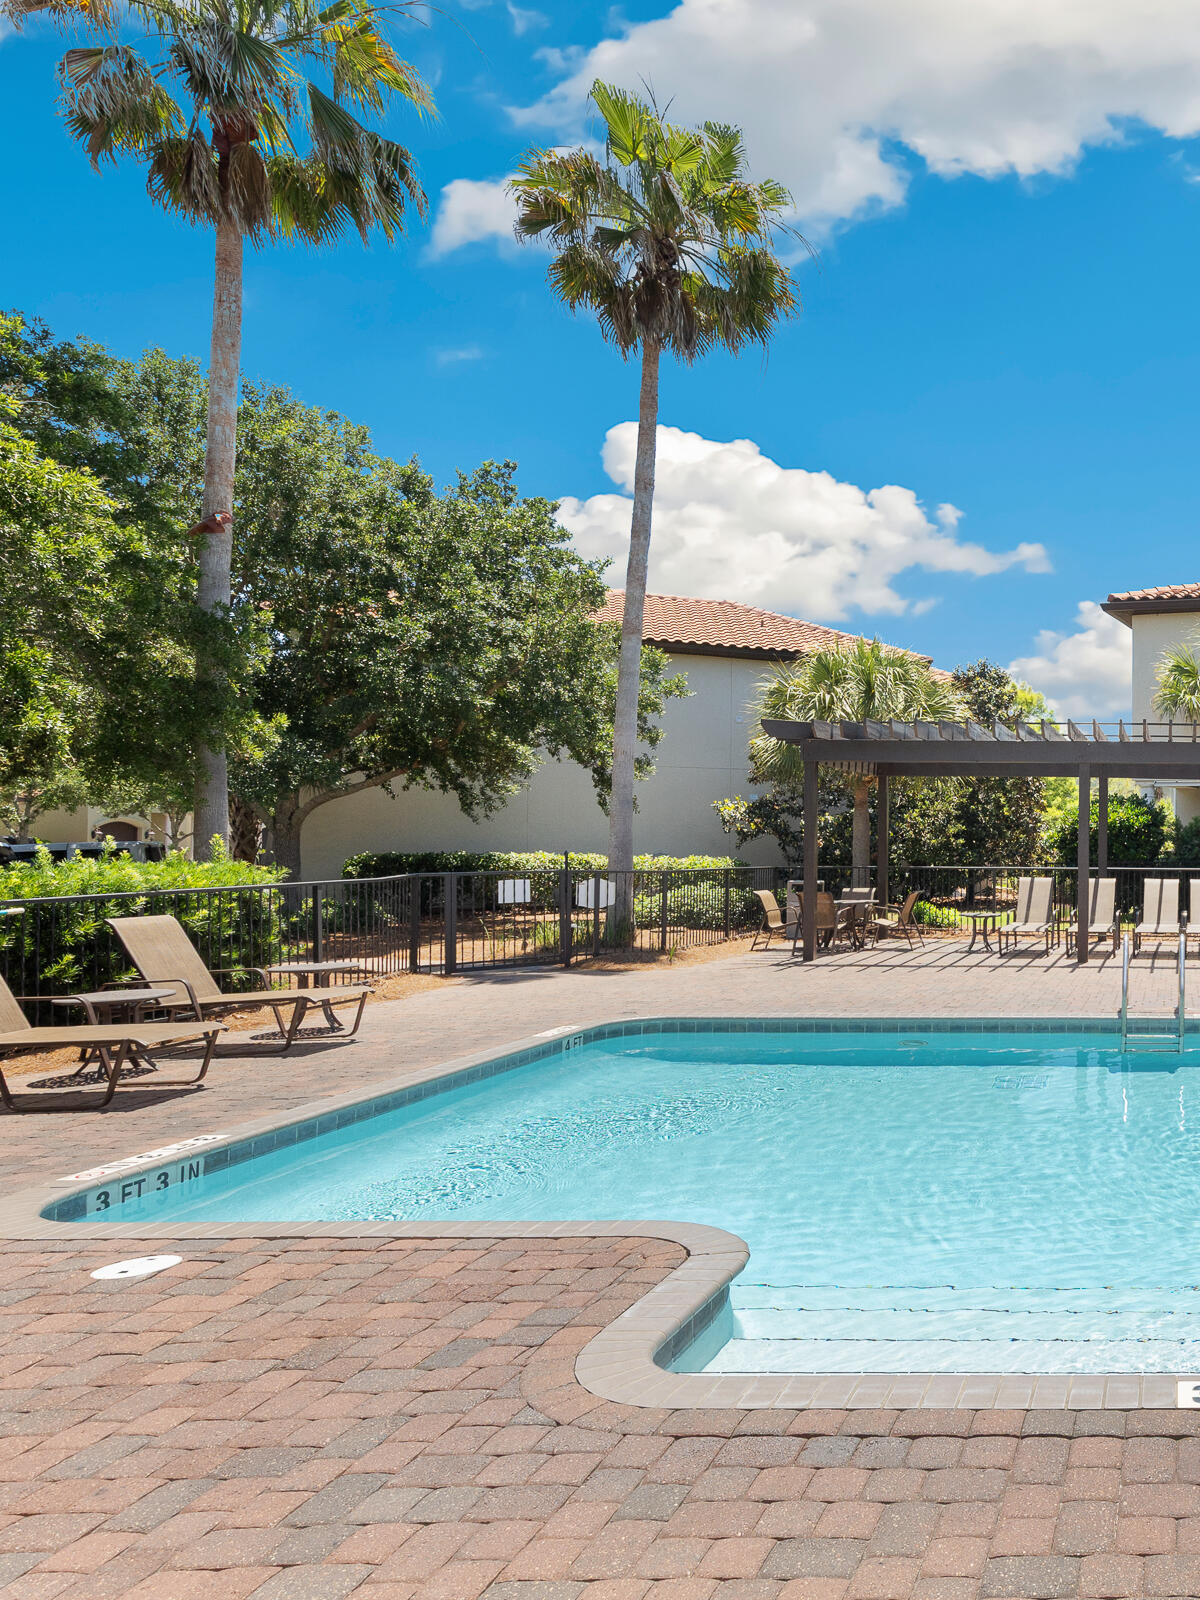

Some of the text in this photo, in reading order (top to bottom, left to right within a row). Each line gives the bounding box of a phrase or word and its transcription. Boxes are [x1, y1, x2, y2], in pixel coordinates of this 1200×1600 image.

[565, 1035, 582, 1050] 4 FT
[96, 1161, 199, 1212] 3 FT 3 IN
